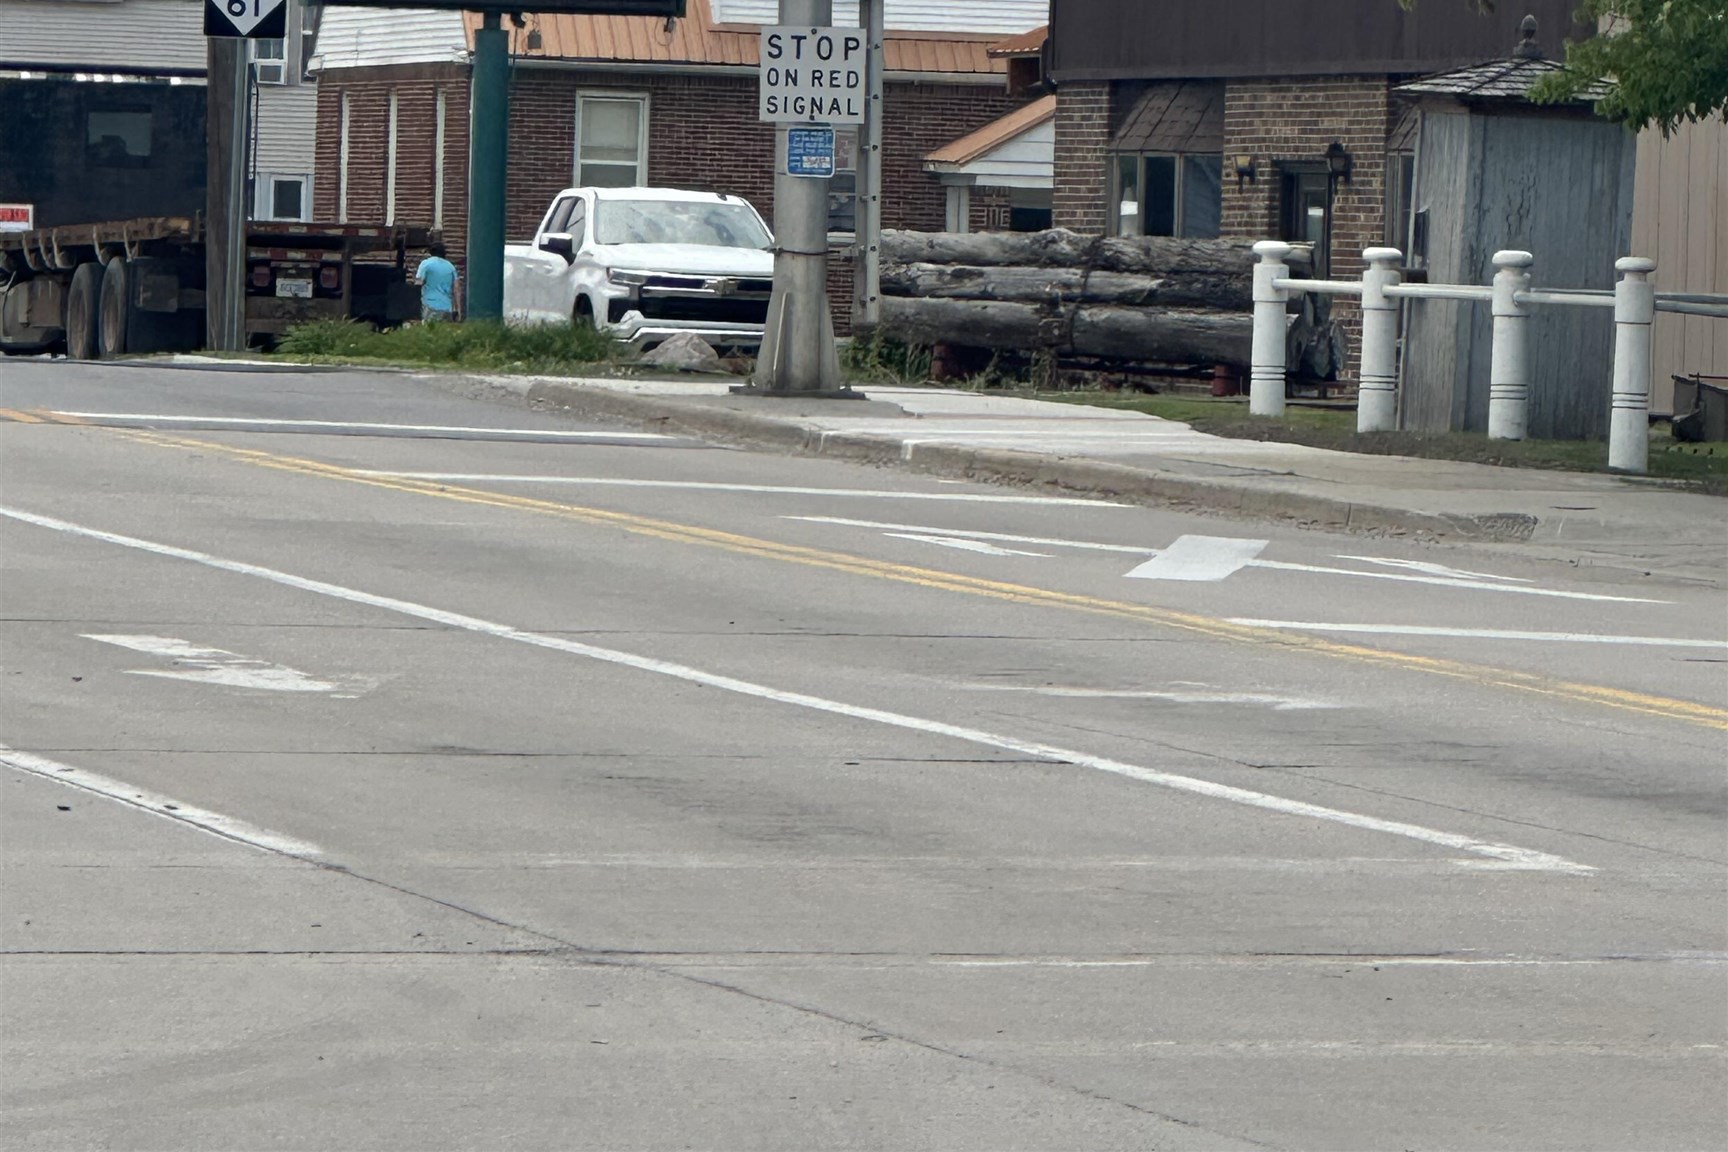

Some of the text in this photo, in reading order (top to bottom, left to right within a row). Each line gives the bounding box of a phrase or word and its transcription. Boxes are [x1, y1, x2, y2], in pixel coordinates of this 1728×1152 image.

[767, 34, 860, 61] STOP
[767, 68, 859, 88] ON RED
[766, 95, 859, 116] SIGNAL
